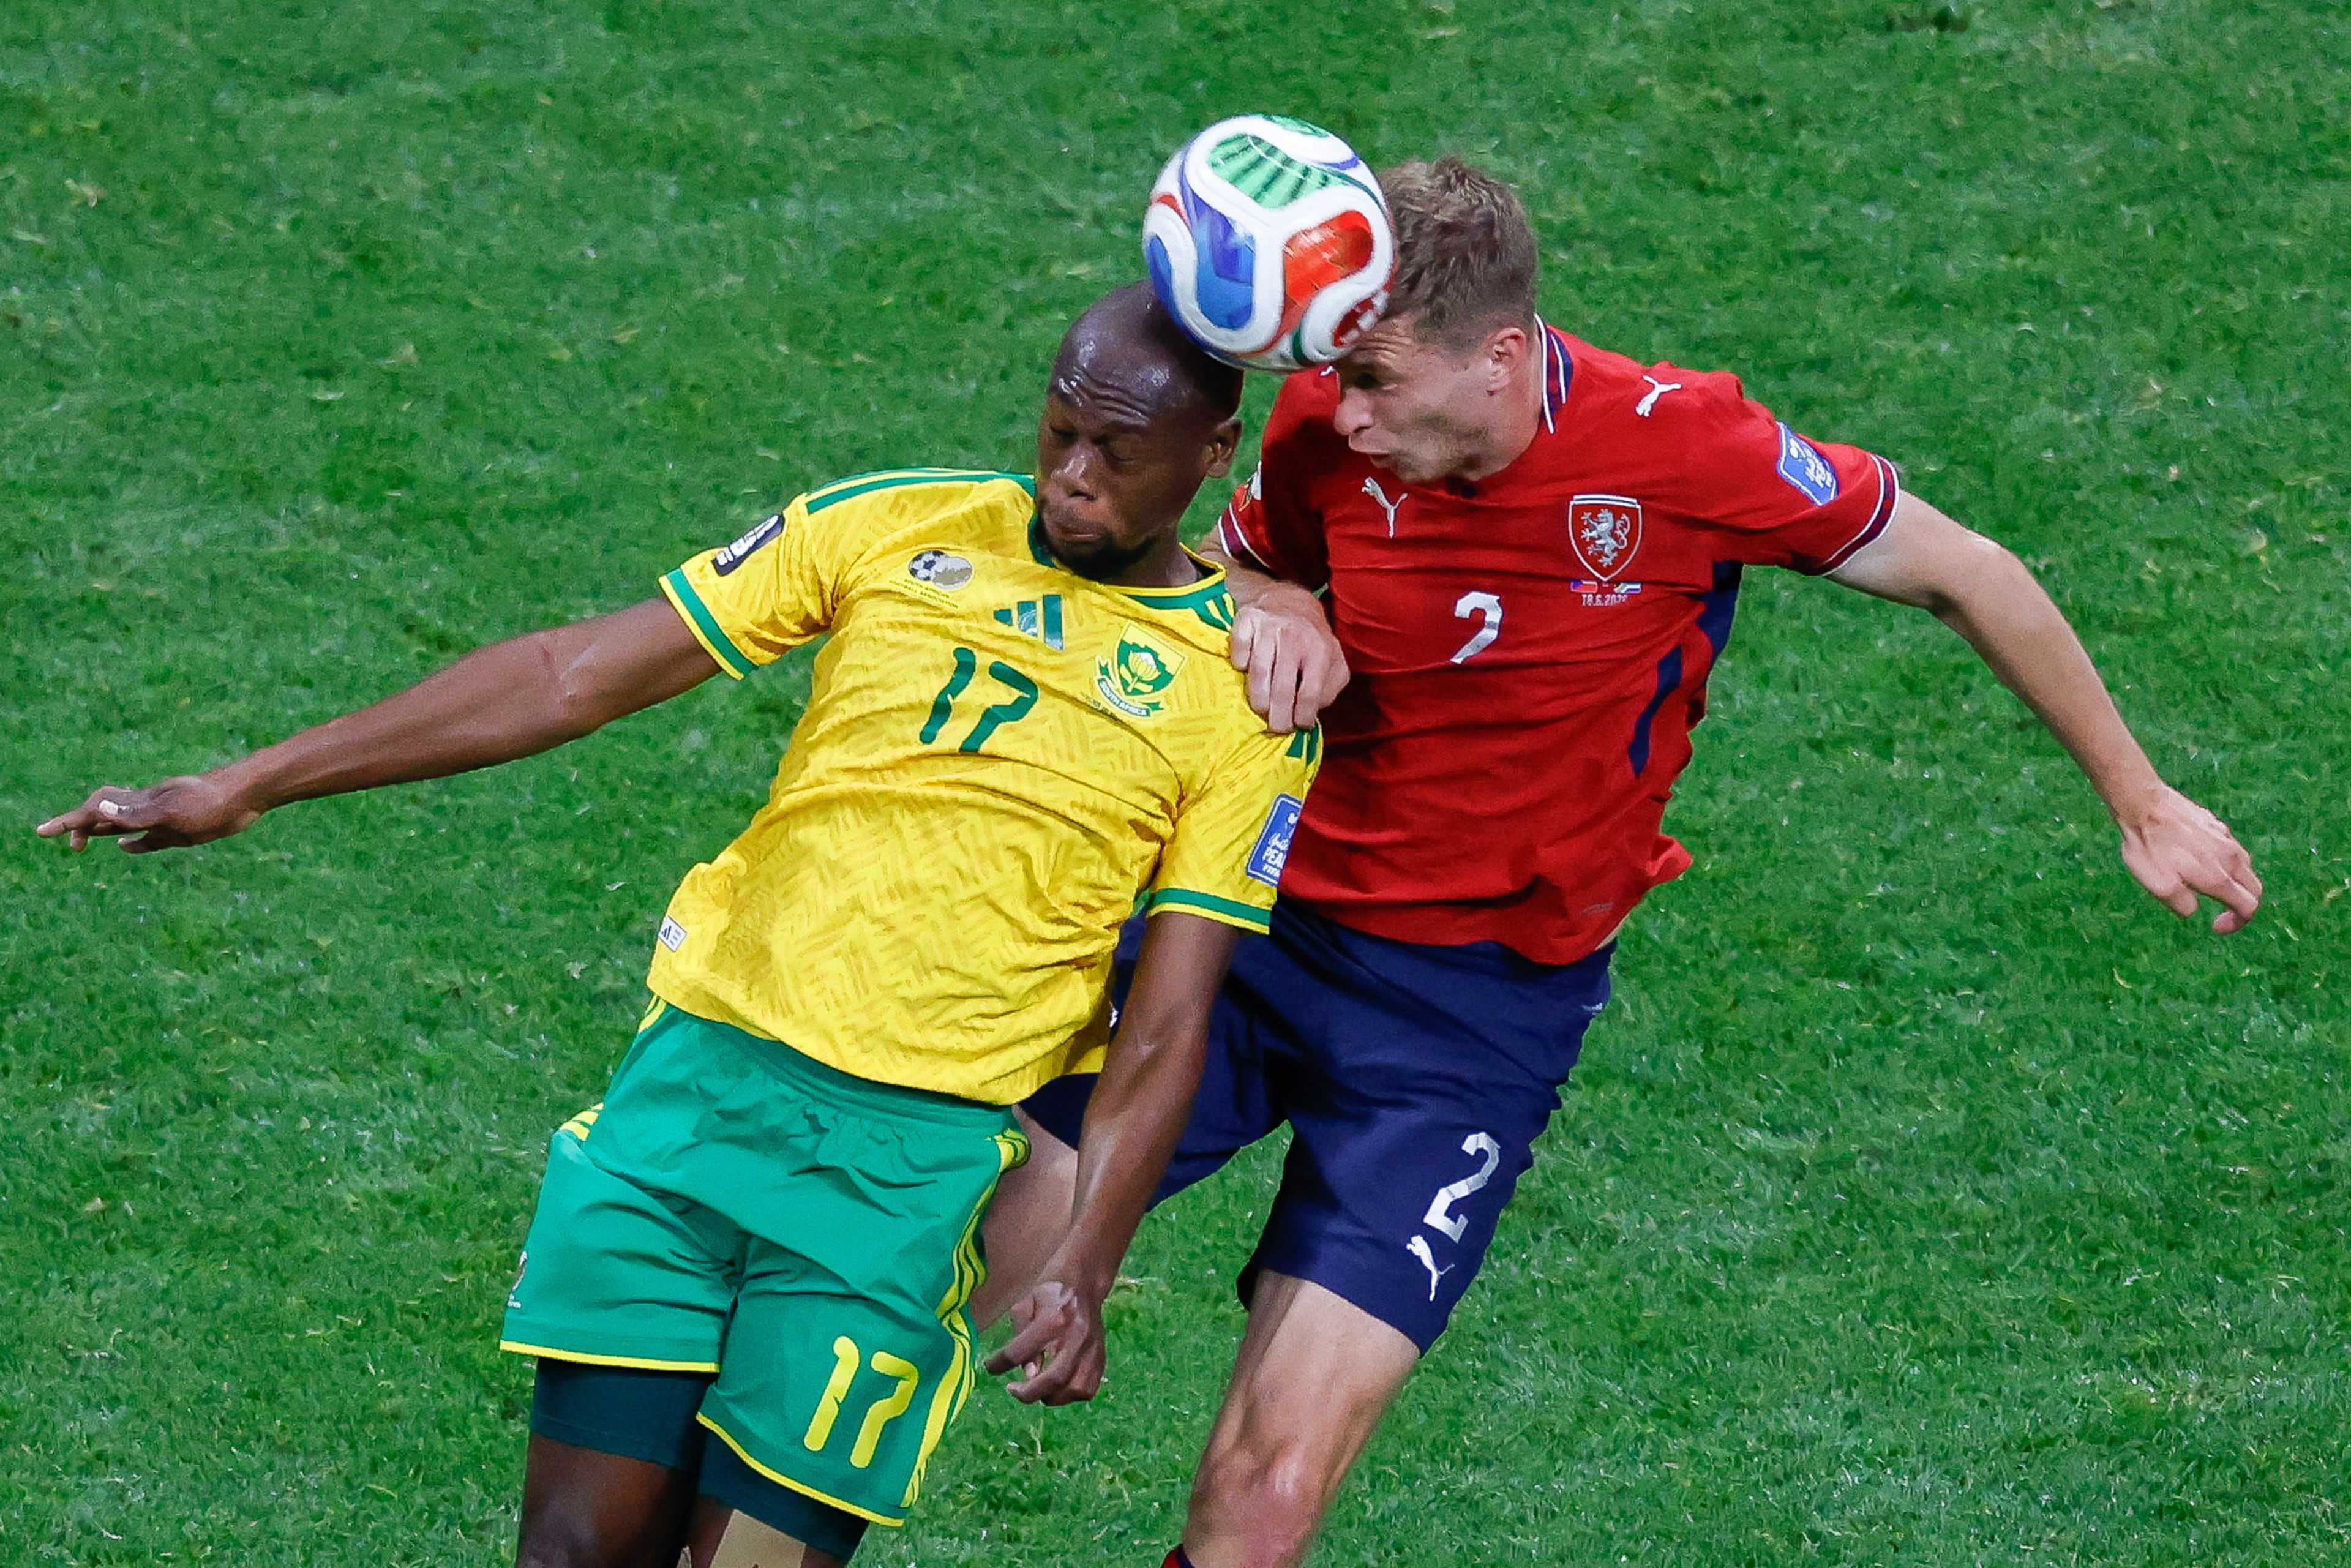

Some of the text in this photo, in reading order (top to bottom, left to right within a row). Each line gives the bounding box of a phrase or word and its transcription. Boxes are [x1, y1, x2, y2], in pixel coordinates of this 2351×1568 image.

[1449, 590, 1504, 664] 2
[919, 647, 1038, 752] 17
[1099, 681, 1121, 706] SOUTH
[1119, 701, 1148, 716] AFRICA
[1262, 847, 1286, 869] PEA
[1423, 1131, 1501, 1243] 2
[803, 1335, 920, 1468] 17
